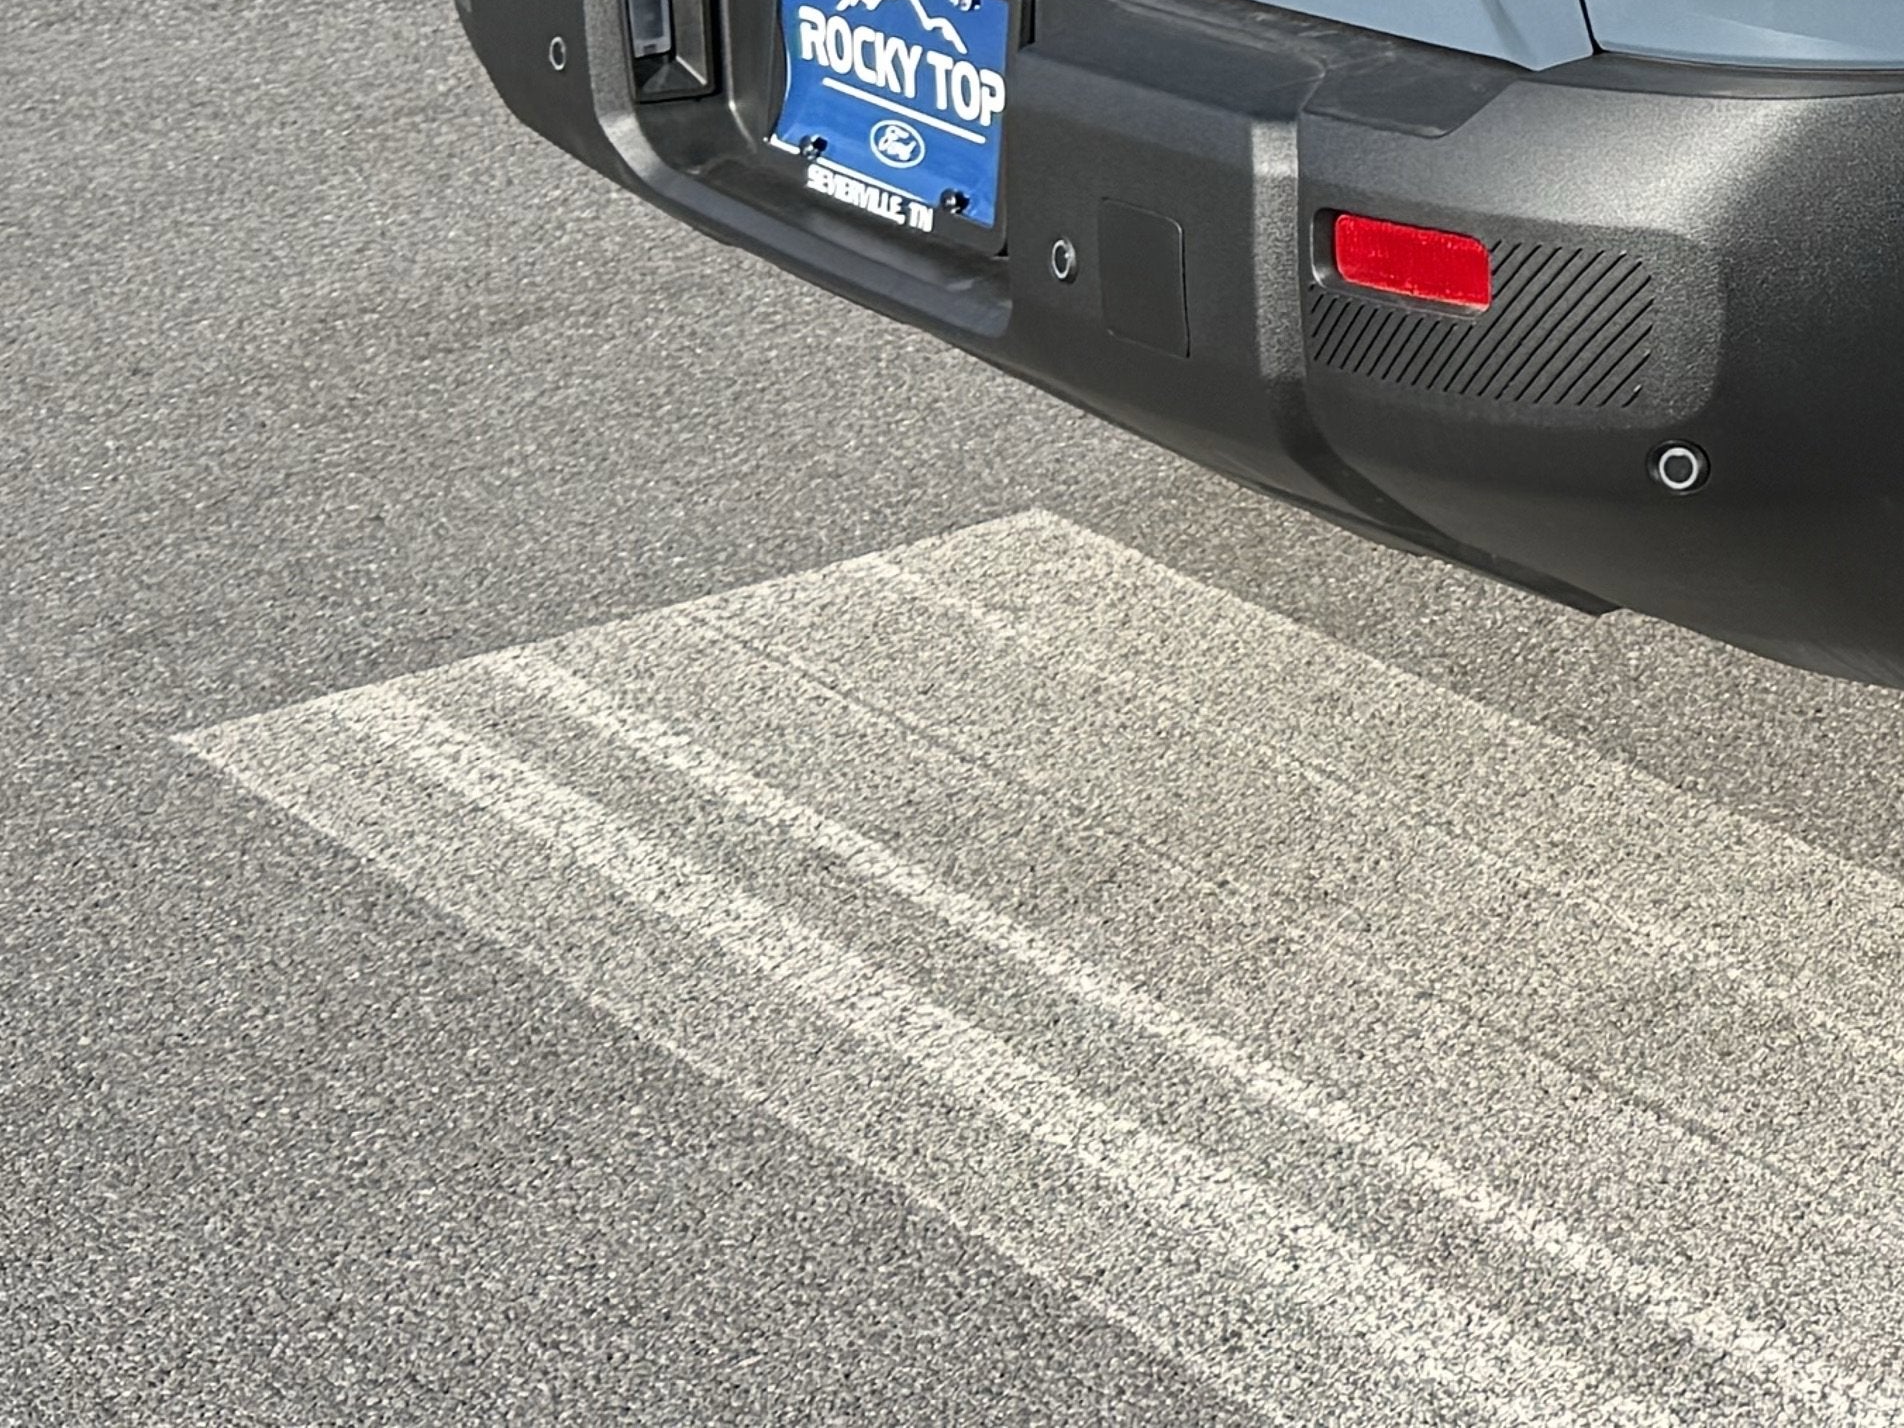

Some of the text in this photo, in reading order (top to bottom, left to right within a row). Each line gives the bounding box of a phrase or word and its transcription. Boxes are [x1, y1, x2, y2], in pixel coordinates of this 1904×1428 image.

[799, 5, 1006, 127] ROCKY TOP
[908, 201, 934, 233] TN
